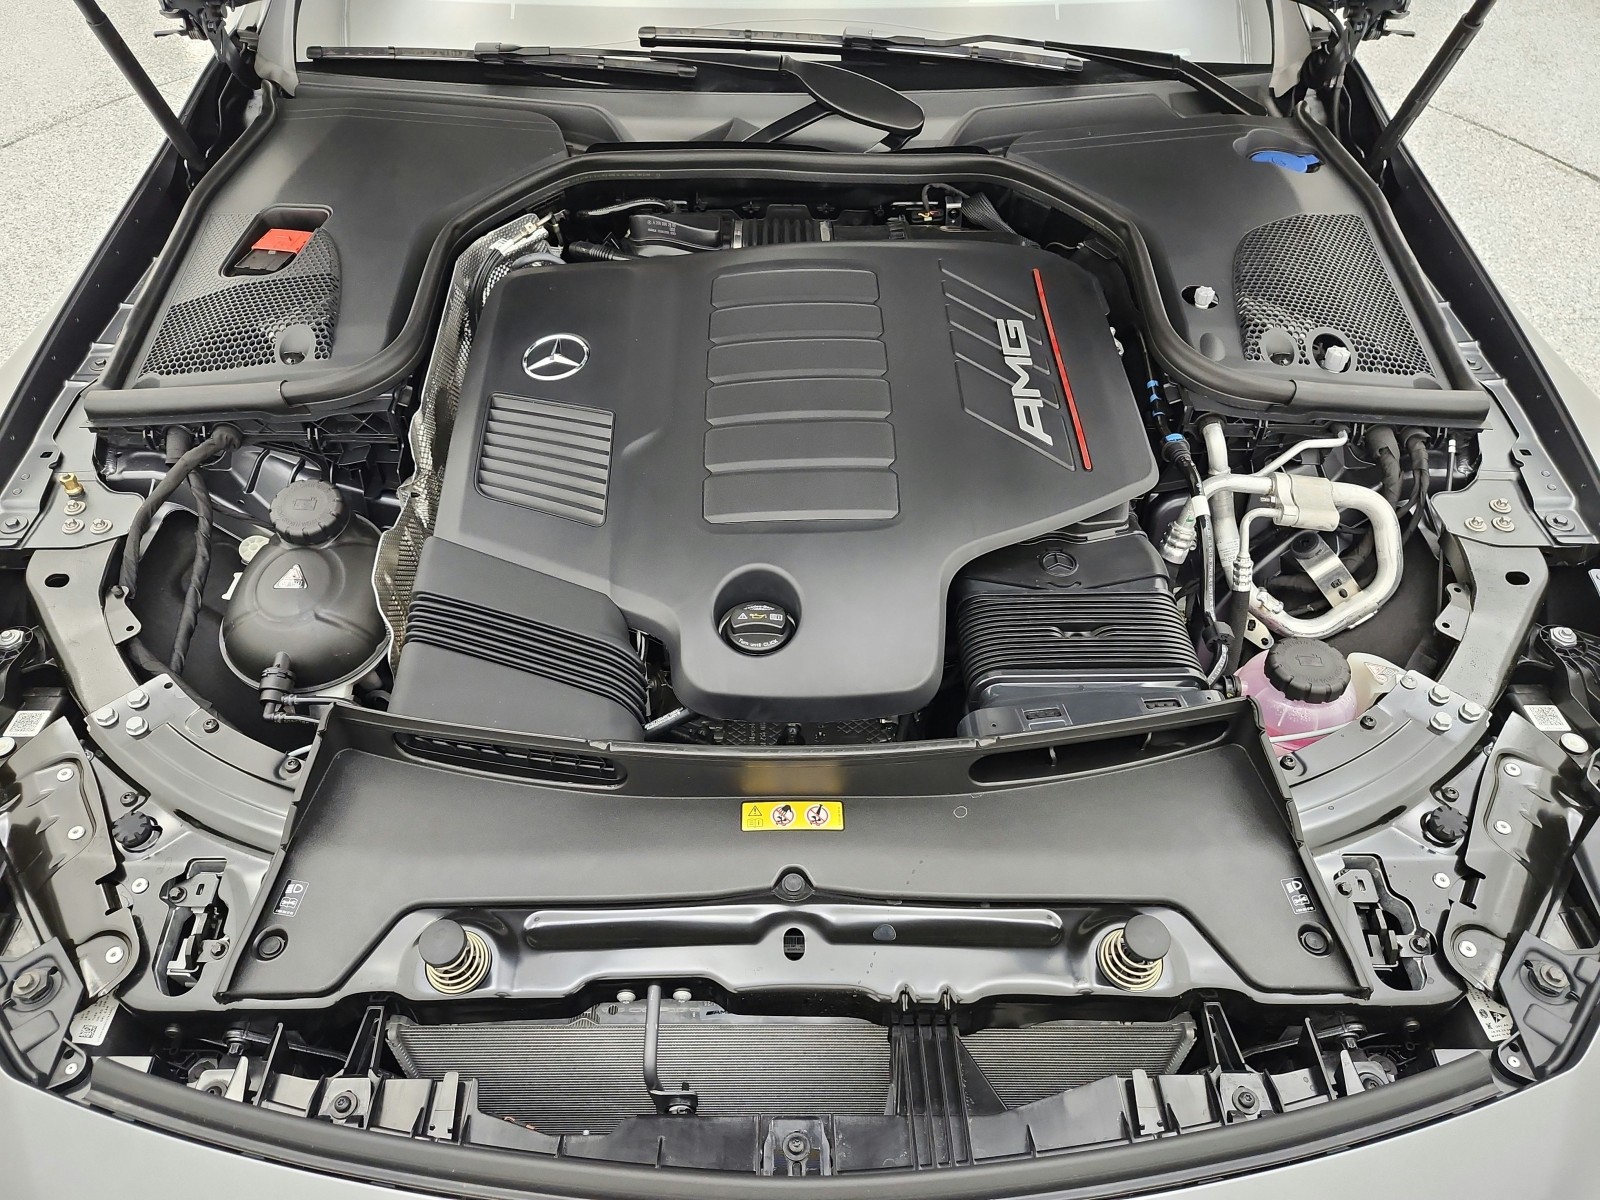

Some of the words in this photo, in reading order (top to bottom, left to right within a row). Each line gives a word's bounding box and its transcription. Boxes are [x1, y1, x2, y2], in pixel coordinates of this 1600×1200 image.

[996, 319, 1053, 446] AMG
[738, 638, 749, 646] Turn
[763, 638, 779, 647] CLICK
